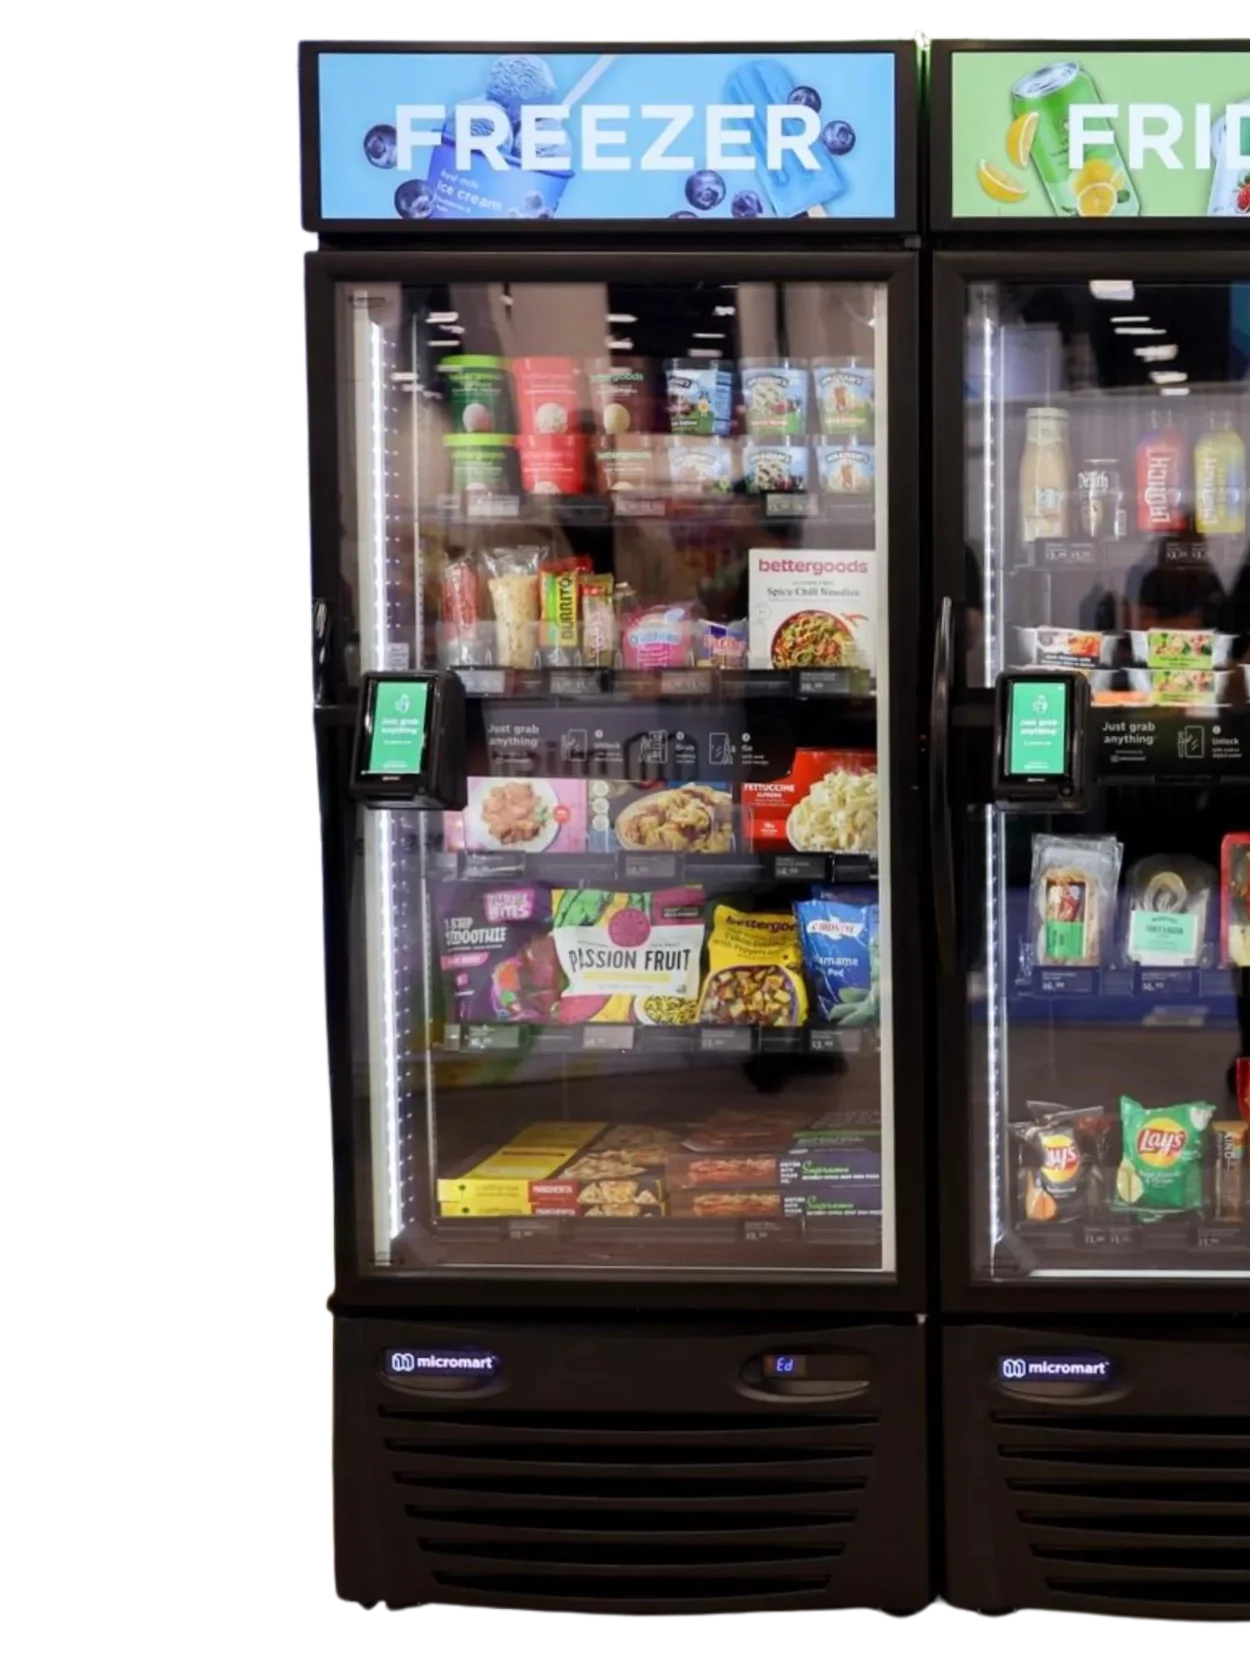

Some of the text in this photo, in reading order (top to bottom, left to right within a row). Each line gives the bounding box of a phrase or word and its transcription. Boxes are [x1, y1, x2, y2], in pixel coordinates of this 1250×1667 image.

[396, 105, 821, 171] FREEZER
[758, 559, 868, 575] bettergoods
[766, 587, 792, 597] Spicy
[559, 576, 573, 640] BURRITO
[489, 724, 539, 735] Just grab
[1102, 721, 1155, 733] Just grab
[488, 737, 538, 749] anything
[1104, 734, 1154, 746] anything
[644, 949, 691, 971] FRUIT
[417, 1355, 492, 1369] micromart
[1029, 1361, 1104, 1375] micromart
